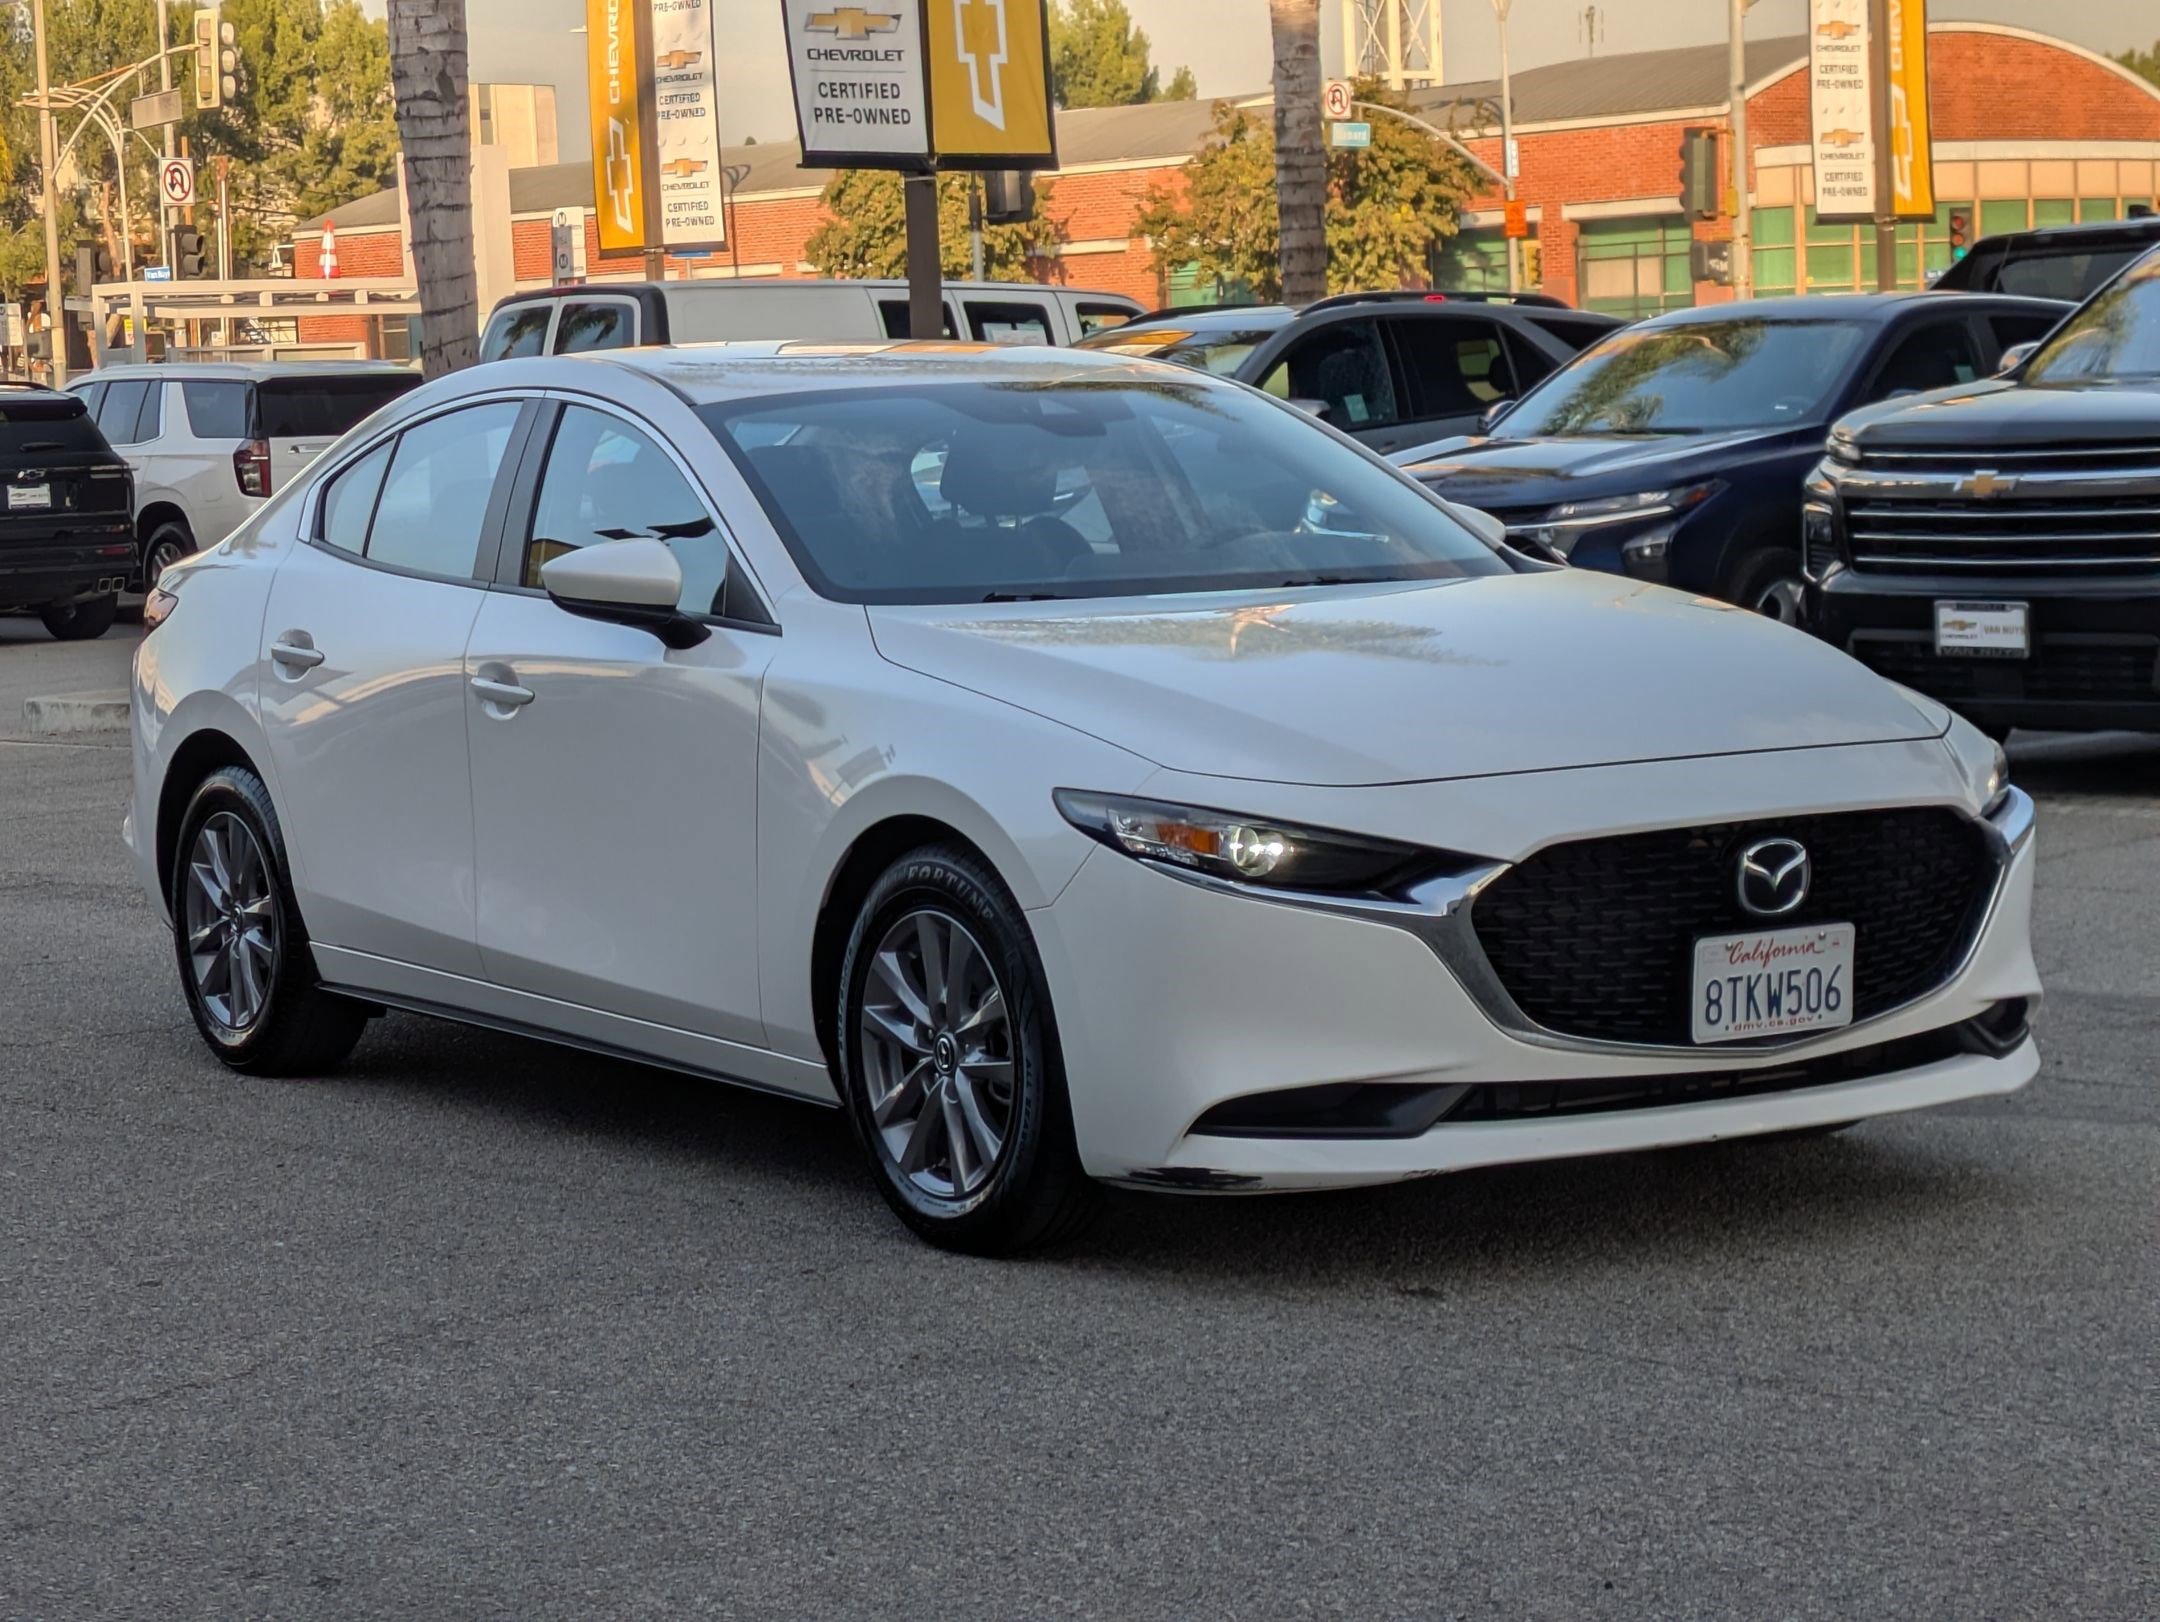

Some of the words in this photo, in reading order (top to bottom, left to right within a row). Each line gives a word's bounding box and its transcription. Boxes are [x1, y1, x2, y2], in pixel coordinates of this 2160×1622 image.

[653, 0, 703, 12] PRE-OWNED
[1816, 44, 1861, 52] CHEVROLET
[807, 48, 904, 61] CHEVROLET
[1819, 64, 1859, 74] CERTIFIED
[655, 72, 703, 84] CHEVROLET
[1816, 79, 1864, 89] PRE-OWNED
[818, 82, 901, 99] CERTIFIED
[659, 92, 701, 105] CERTIFIED
[656, 107, 705, 120] PRE-OWNED
[814, 107, 911, 125] PRE-OWNED
[1820, 152, 1865, 161] CHEVROLET
[1824, 171, 1864, 182] CERTIFIED
[662, 181, 710, 191] CHEVROLET
[1822, 186, 1868, 197] PRE-OWNED
[667, 201, 709, 212] CERTIFIED
[665, 215, 715, 228] PRE-OWNED
[1729, 936, 1825, 969] California
[1705, 963, 1842, 1026] 8TKW506
[1734, 1015, 1815, 1032] dmv.ca.gov
